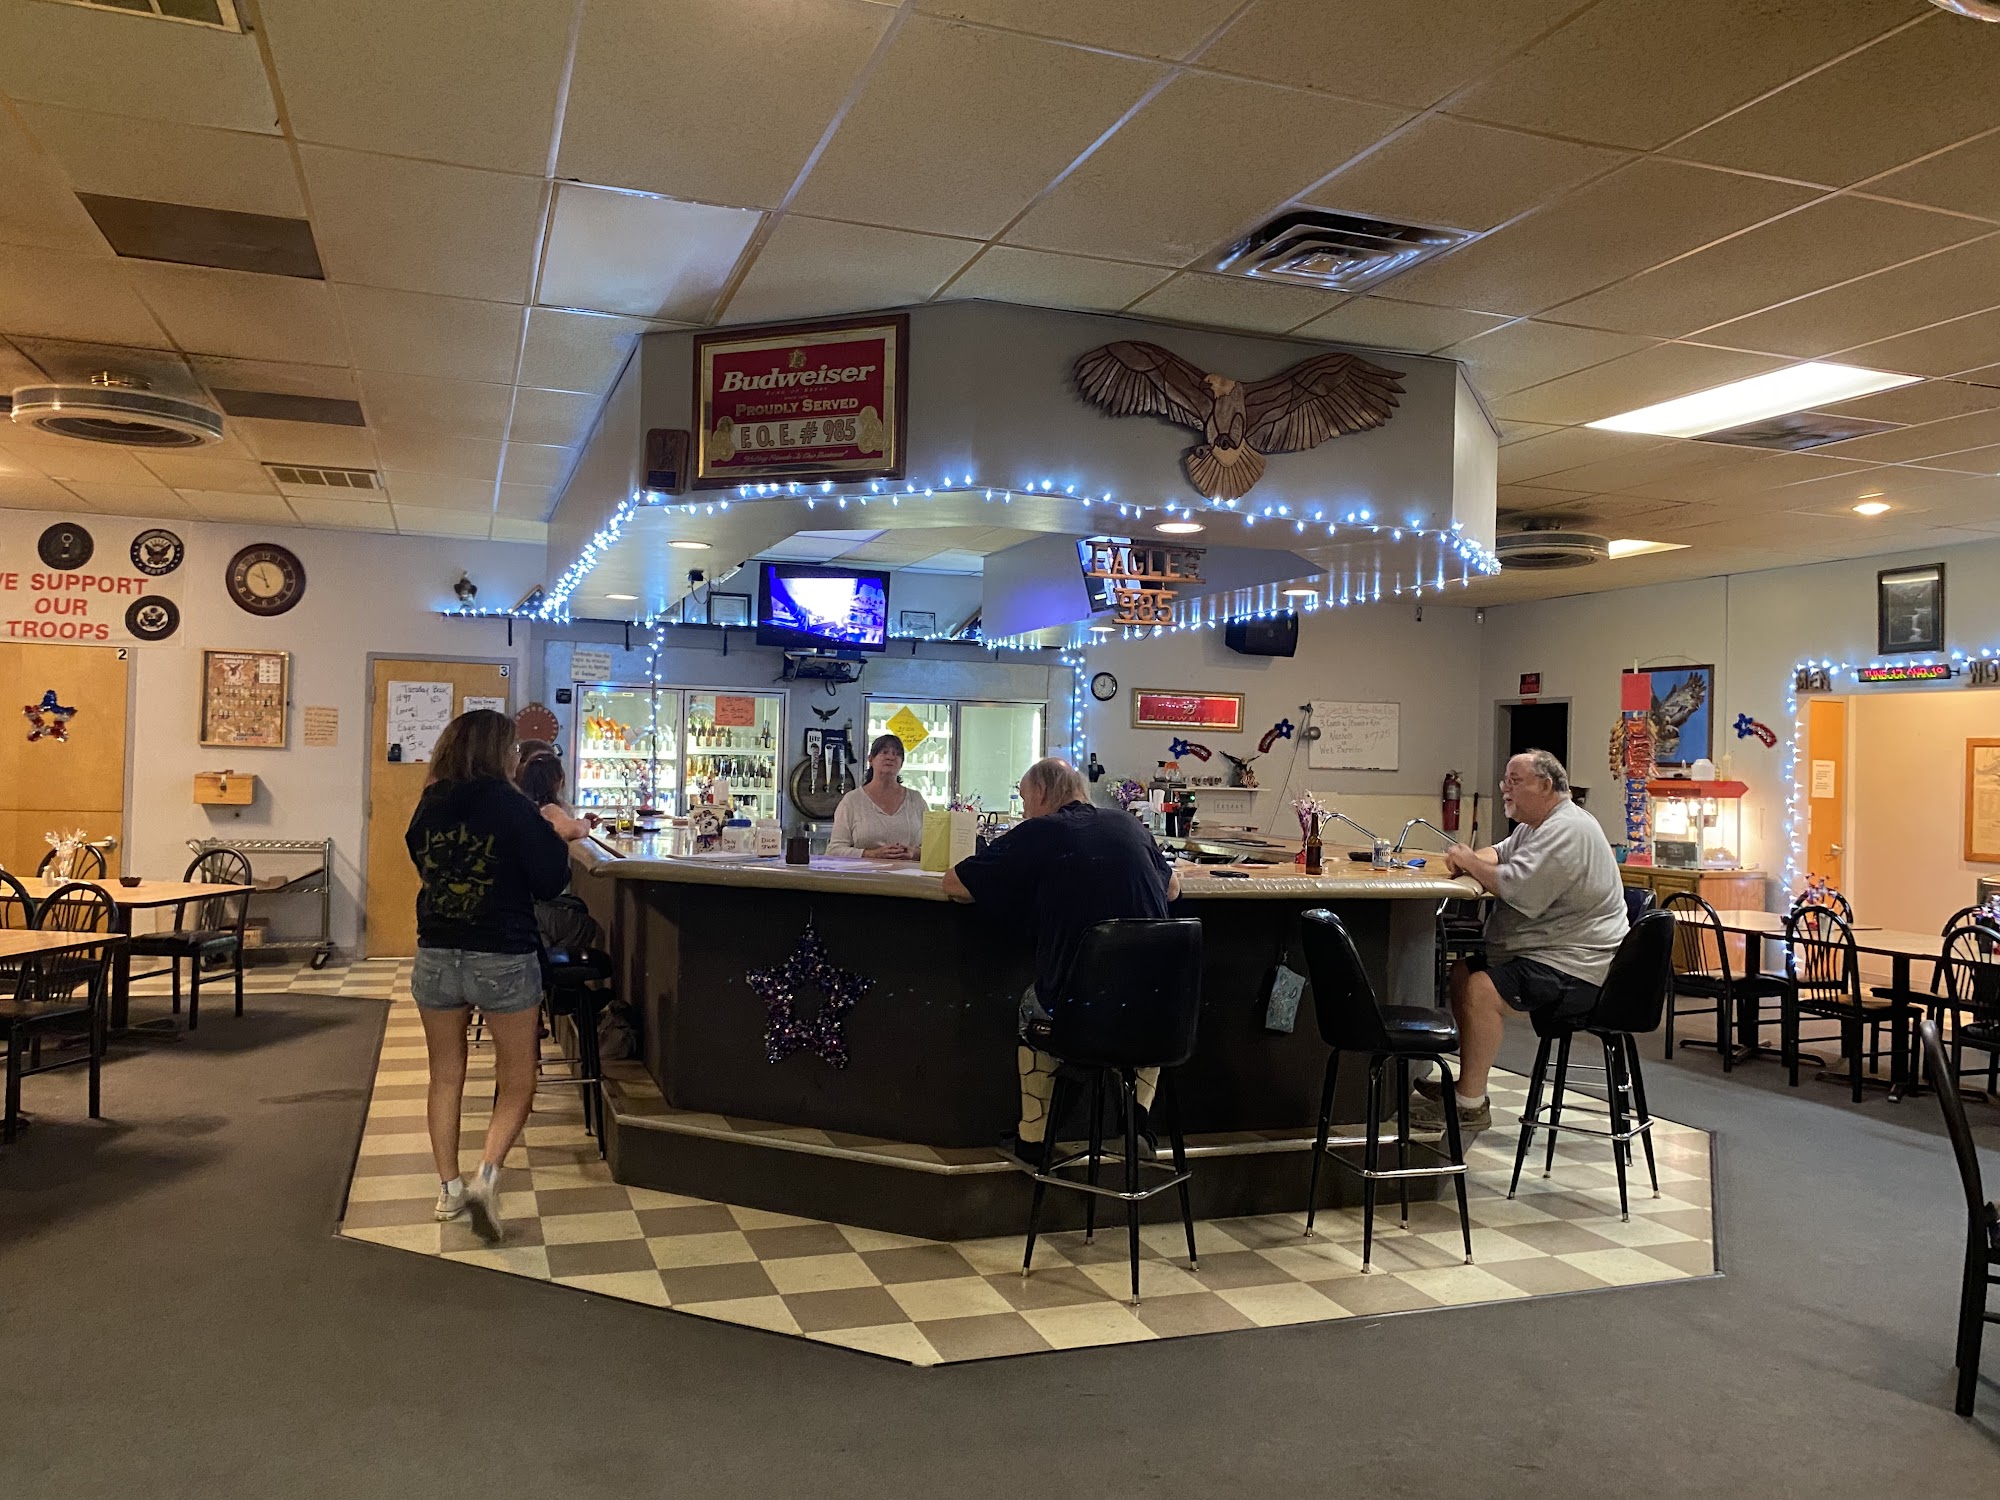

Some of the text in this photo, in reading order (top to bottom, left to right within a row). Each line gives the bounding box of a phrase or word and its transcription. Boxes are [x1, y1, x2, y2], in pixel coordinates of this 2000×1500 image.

[719, 364, 877, 393] Budweiser
[735, 397, 859, 418] PROUDLY SERVED
[740, 417, 856, 449] F. O. E. # 985
[1091, 543, 1201, 579] EAGLES
[0, 573, 148, 595] E SUPPORT
[34, 597, 88, 616] OUR
[1119, 593, 1173, 621] 985
[7, 620, 110, 640] TROOPS
[118, 649, 127, 660] 2
[500, 666, 508, 677] 3
[809, 735, 821, 743] Lite
